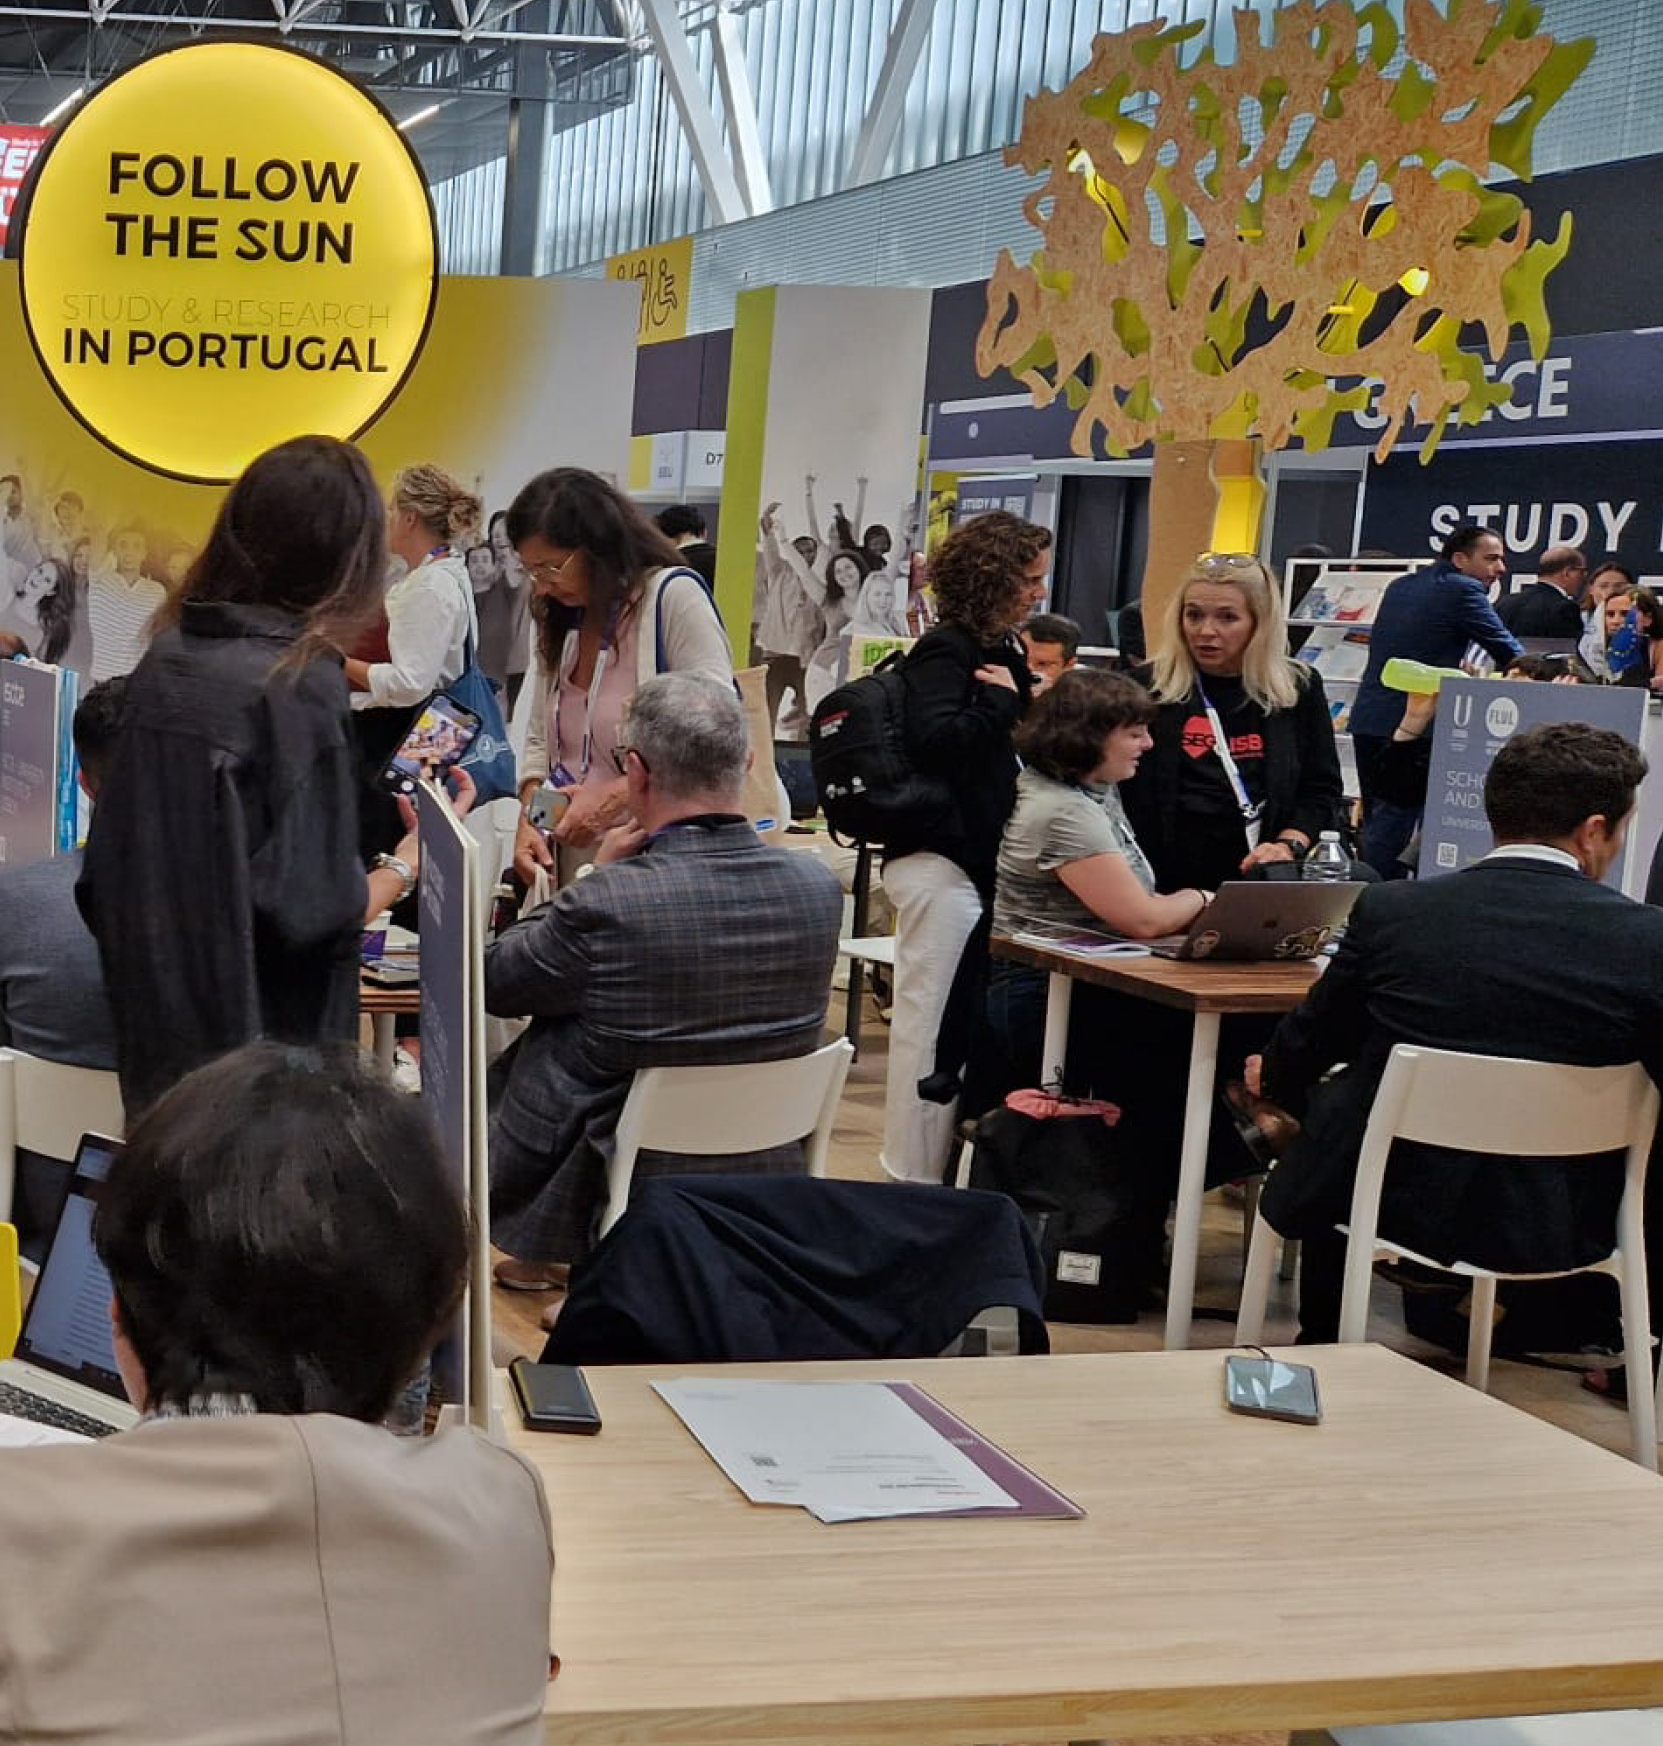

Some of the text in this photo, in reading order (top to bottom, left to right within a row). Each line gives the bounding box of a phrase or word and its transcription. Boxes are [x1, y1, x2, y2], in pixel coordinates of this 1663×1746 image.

[109, 152, 360, 204] FOLLOW
[105, 212, 354, 264] THE SUN
[62, 294, 391, 330] STUDY & RESEARCH
[64, 327, 389, 373] IN PORTUGAL
[1429, 501, 1637, 553] STUDY
[1443, 790, 1480, 809] AND
